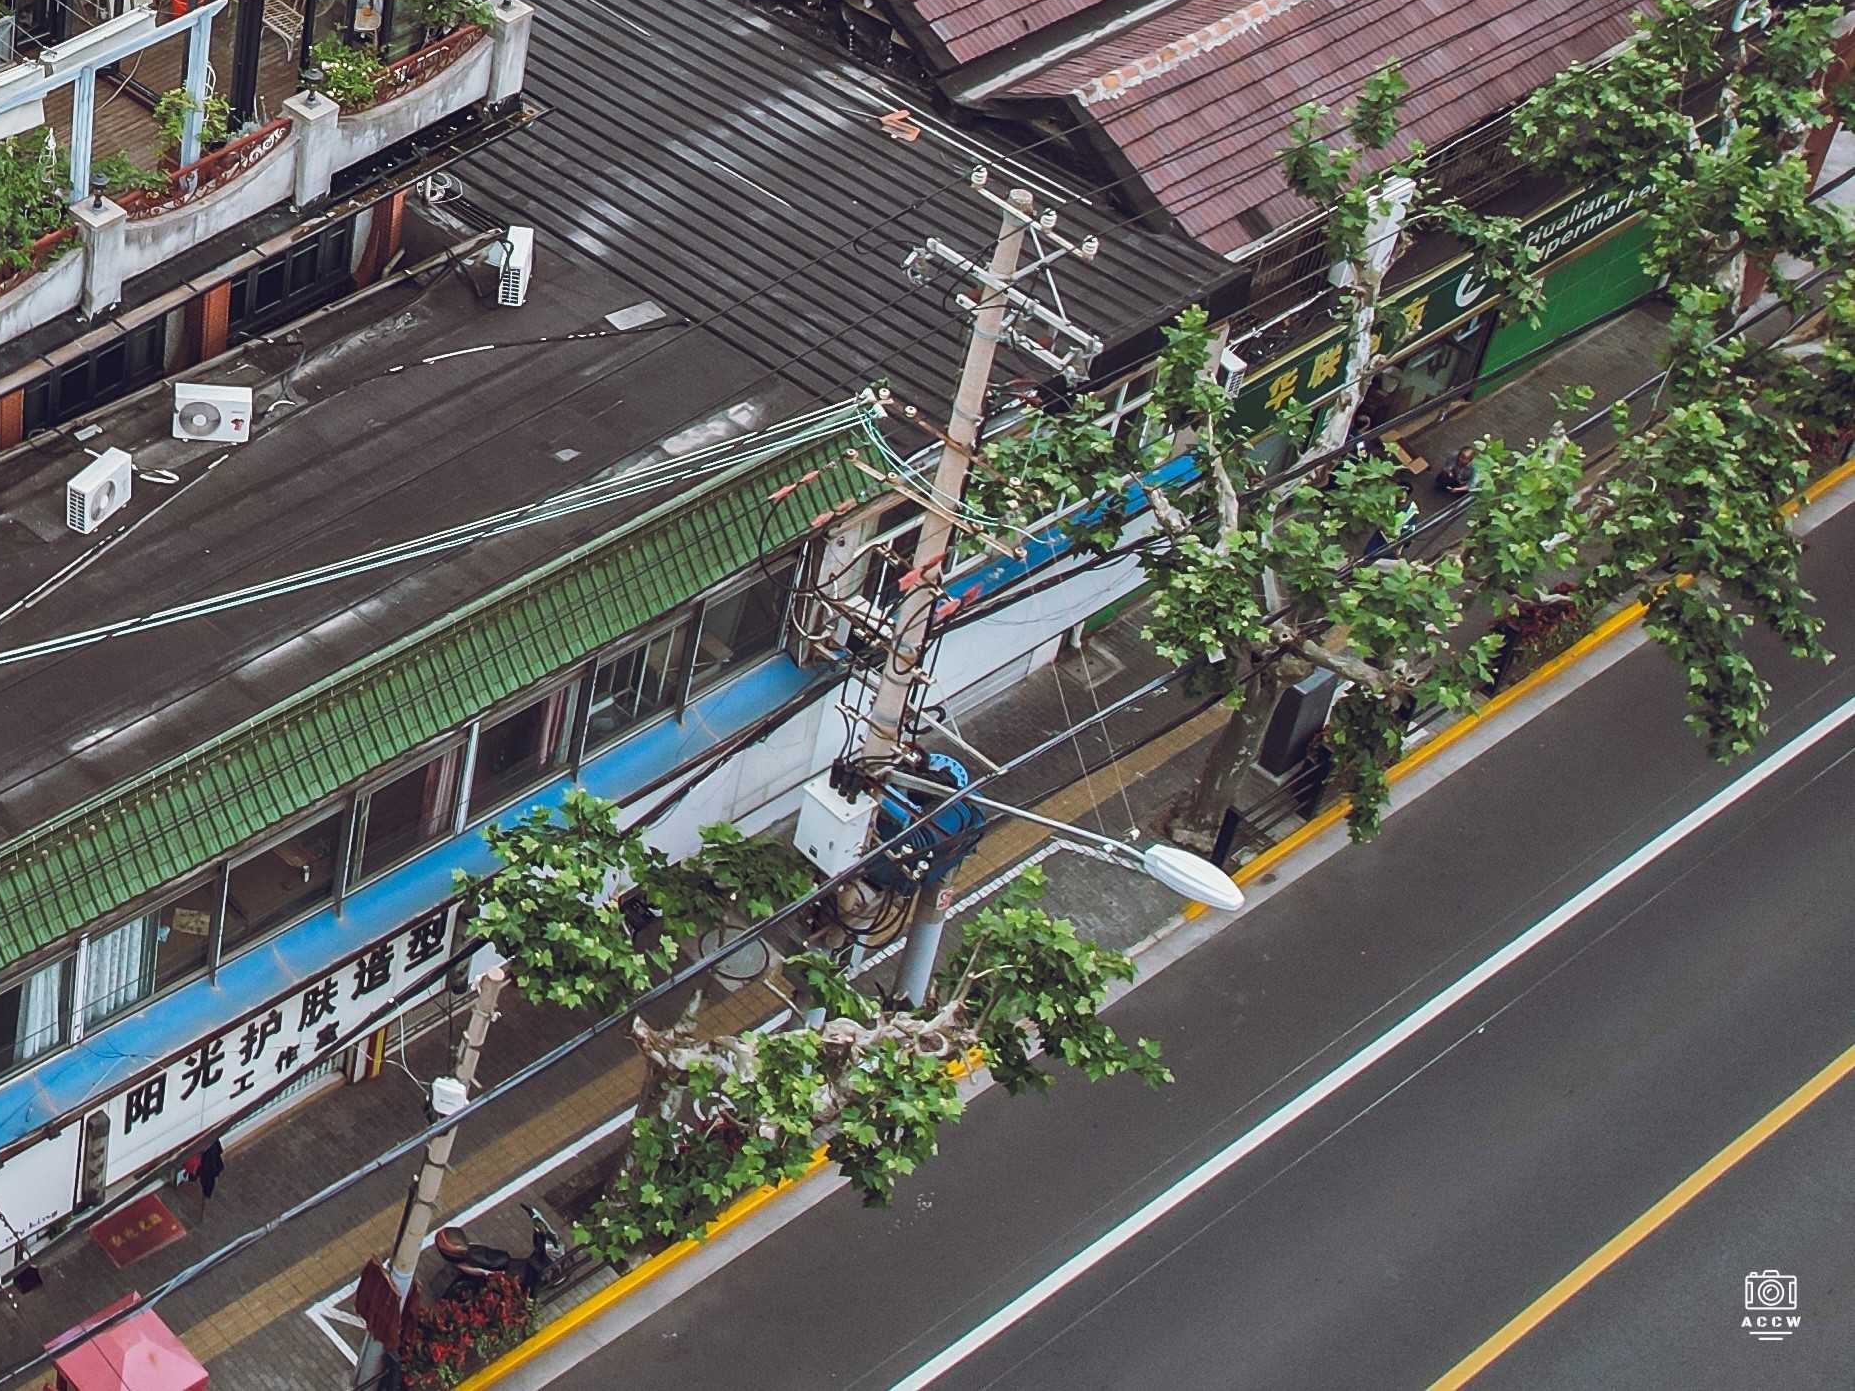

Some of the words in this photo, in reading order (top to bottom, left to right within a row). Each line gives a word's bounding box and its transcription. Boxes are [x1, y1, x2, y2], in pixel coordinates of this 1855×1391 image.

[1526, 193, 1609, 246] Hualian
[1265, 294, 1430, 410] 华联市
[124, 913, 447, 1135] 阳光护肤造型
